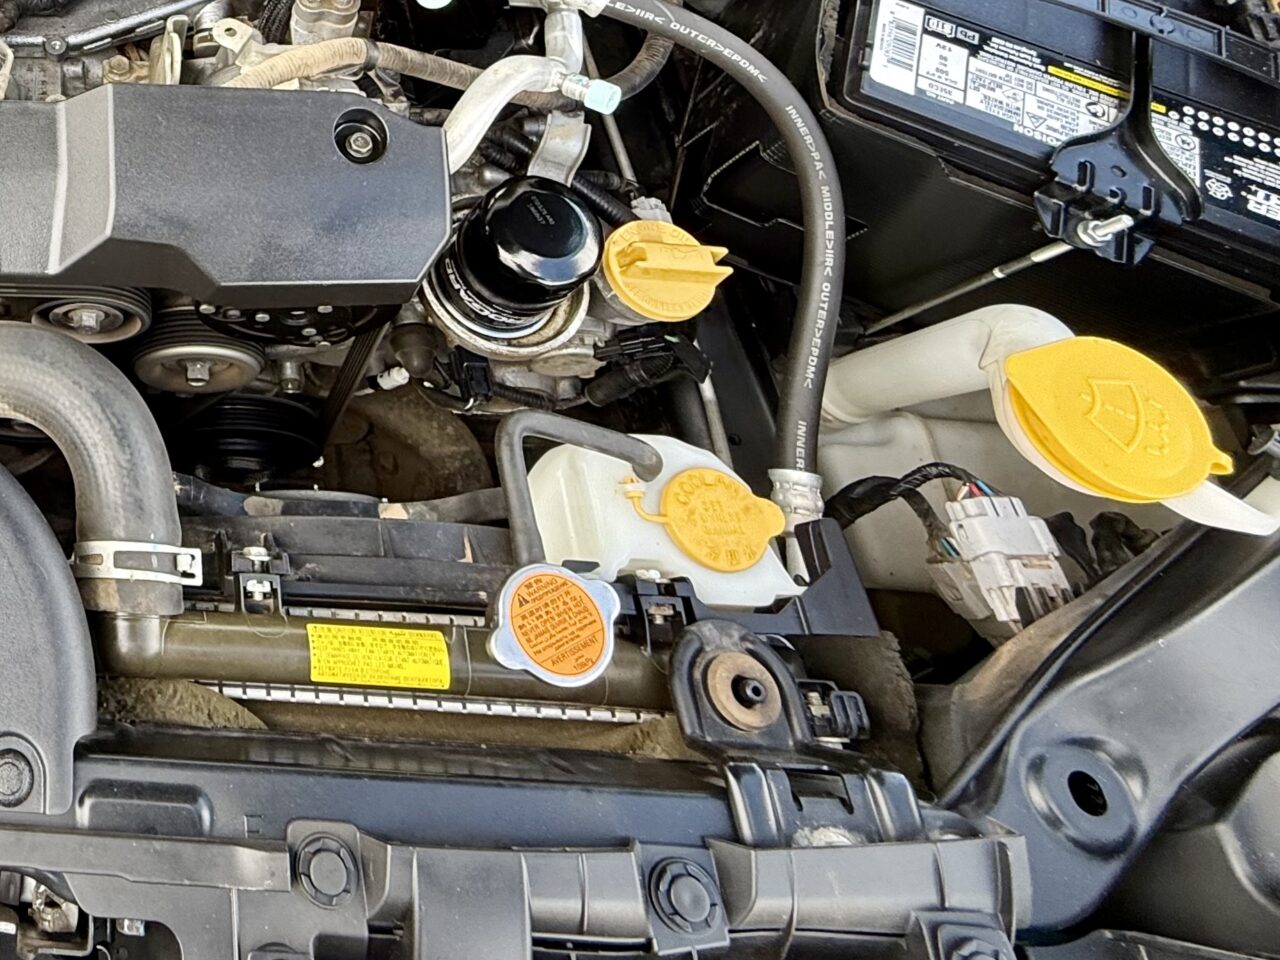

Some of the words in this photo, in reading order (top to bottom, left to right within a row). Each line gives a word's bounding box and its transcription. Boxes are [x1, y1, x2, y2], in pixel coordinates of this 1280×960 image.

[669, 21, 769, 84] OUTER>EPDM<
[959, 30, 976, 43] Pb
[785, 104, 828, 181] INNER>PA<
[820, 185, 835, 278] MIDDLE>IIR<
[803, 281, 832, 390] OUTER>EPDM<
